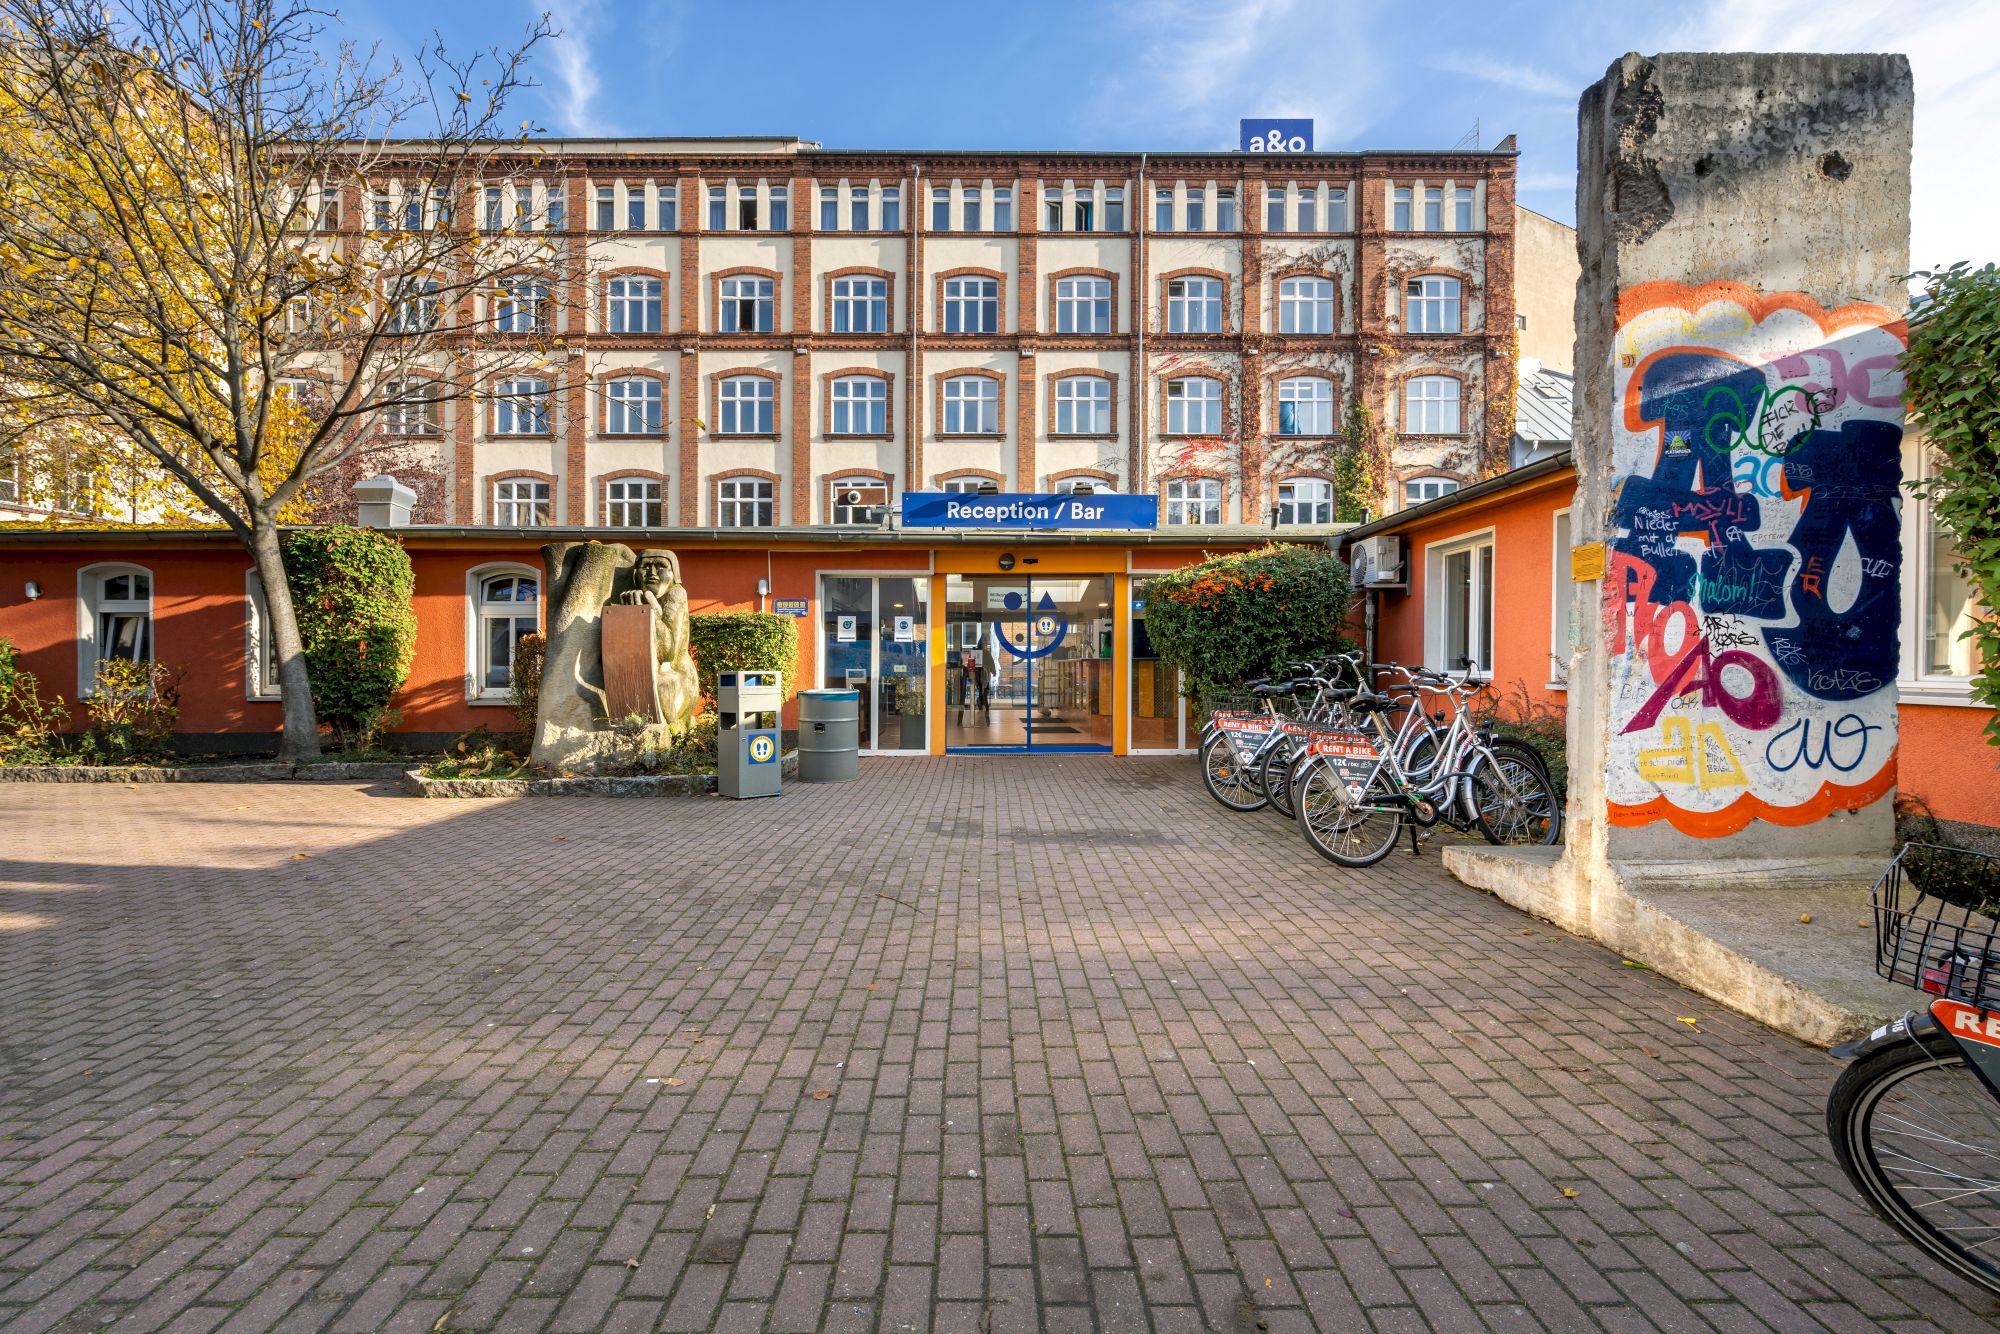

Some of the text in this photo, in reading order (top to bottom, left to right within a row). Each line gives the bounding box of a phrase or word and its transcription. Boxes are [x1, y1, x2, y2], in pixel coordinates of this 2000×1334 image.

[1249, 129, 1306, 152] a&o
[947, 501, 1105, 522] Reception / Bar
[1634, 515, 1680, 532] Nieder
[1322, 744, 1372, 755] RENT A BIKE
[1332, 758, 1347, 766] 12€
[1955, 1010, 2000, 1040] RE
